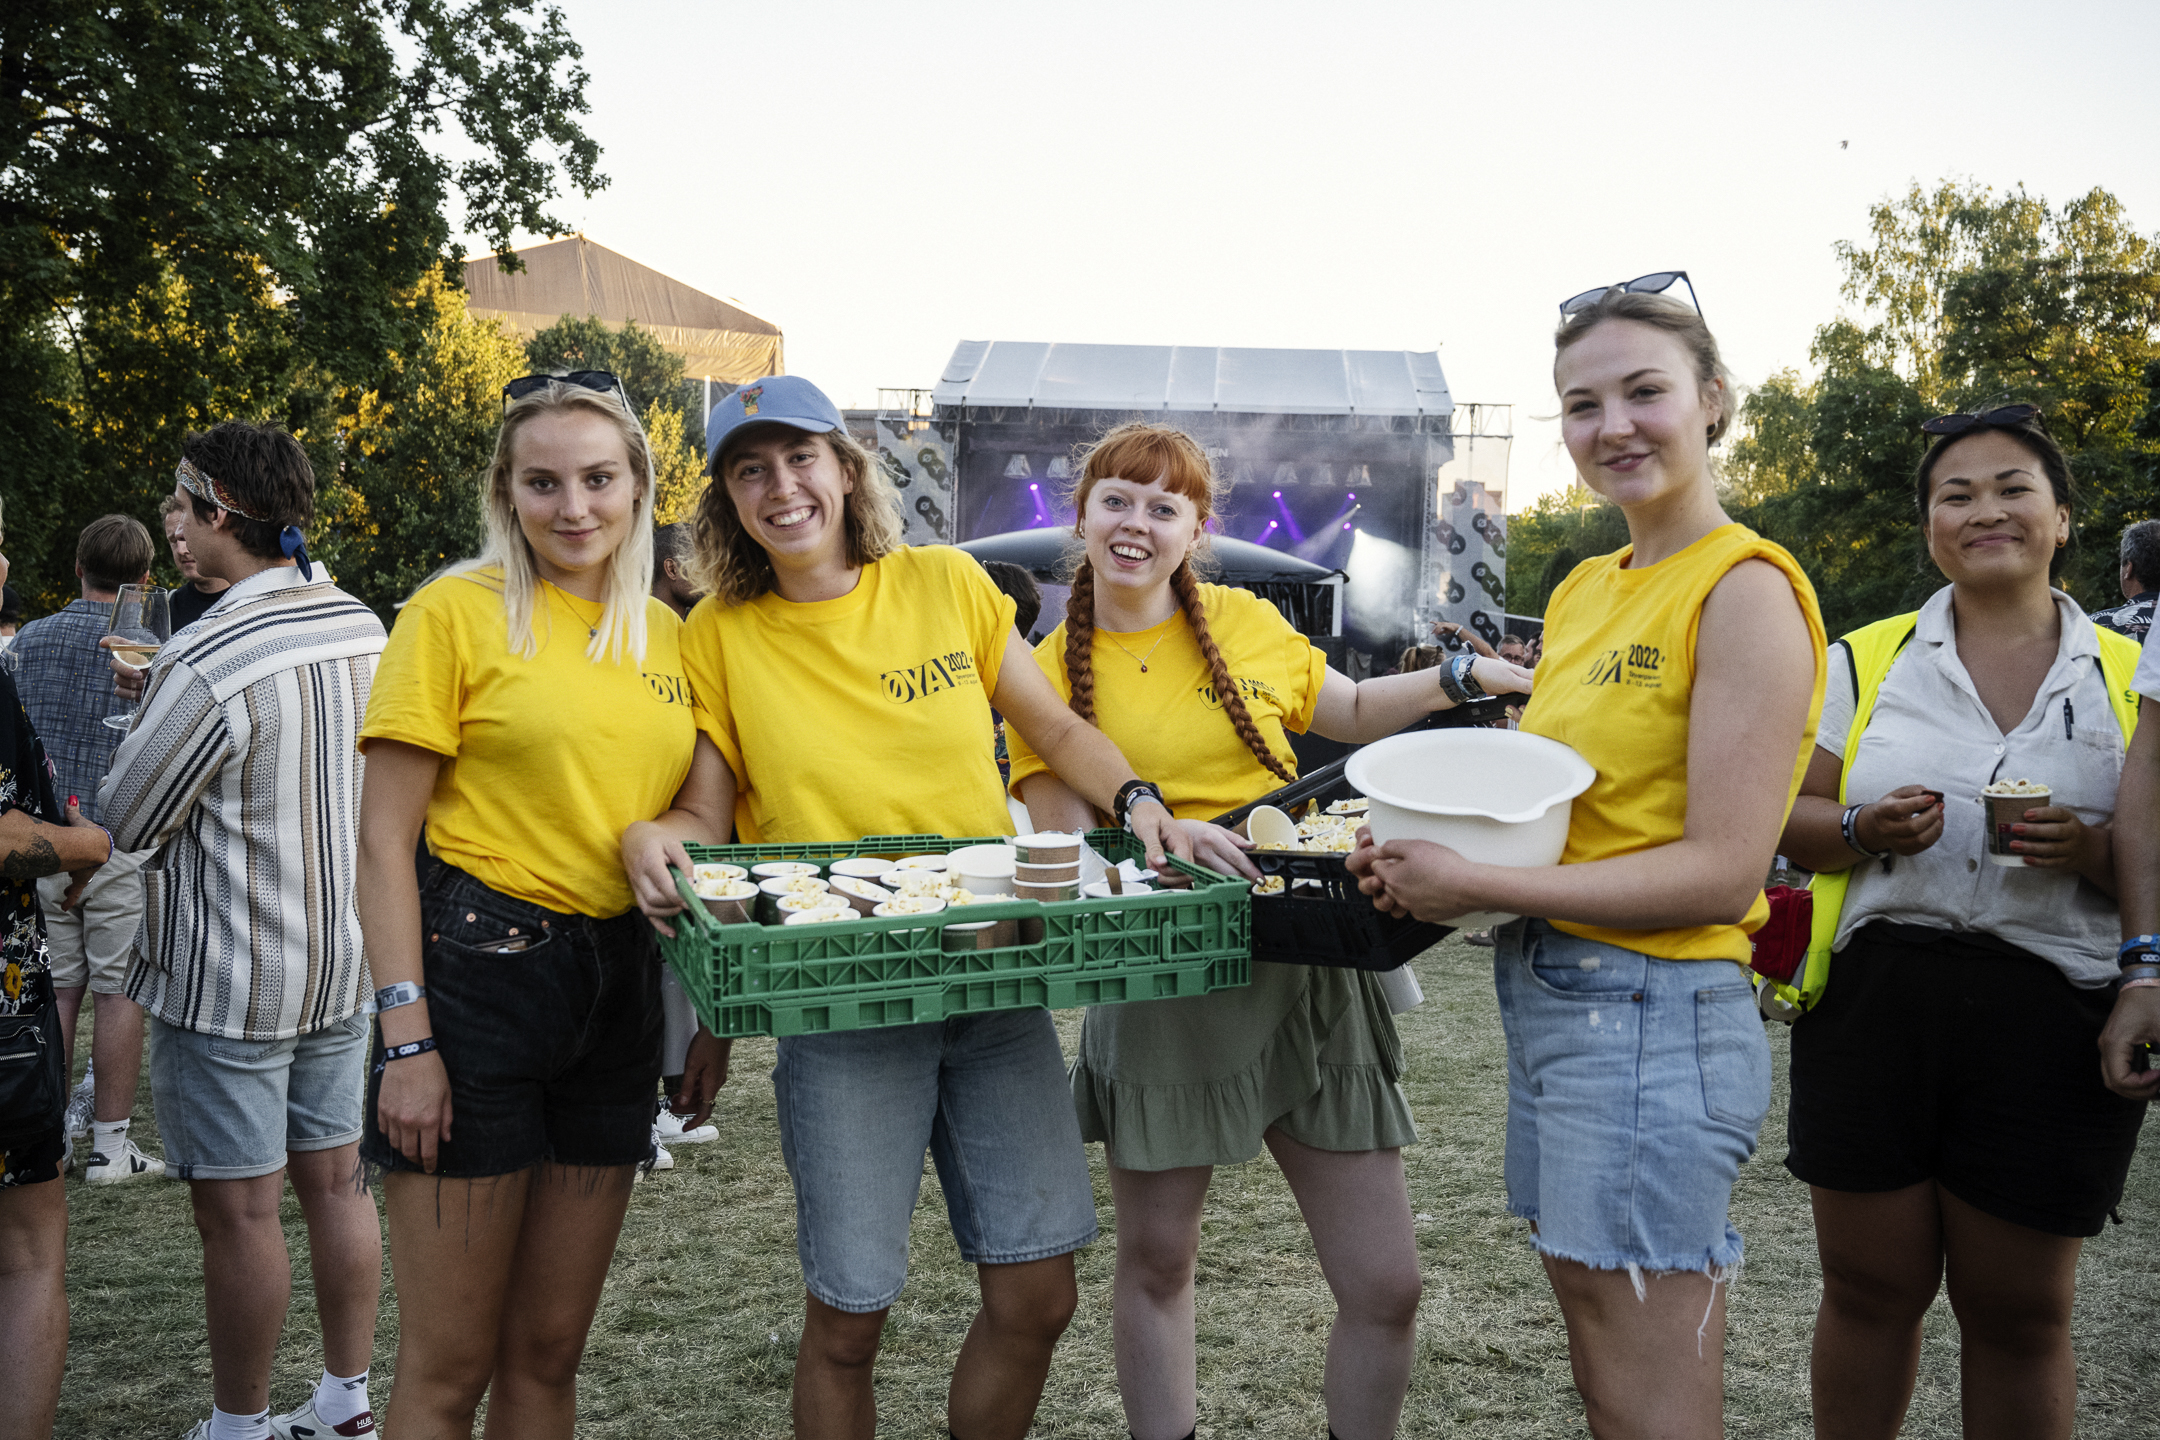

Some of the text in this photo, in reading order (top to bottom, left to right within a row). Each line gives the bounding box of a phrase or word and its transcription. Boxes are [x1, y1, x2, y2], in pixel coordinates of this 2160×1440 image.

[1627, 644, 1660, 670] 2022
[880, 651, 971, 704] ØYA 2022
